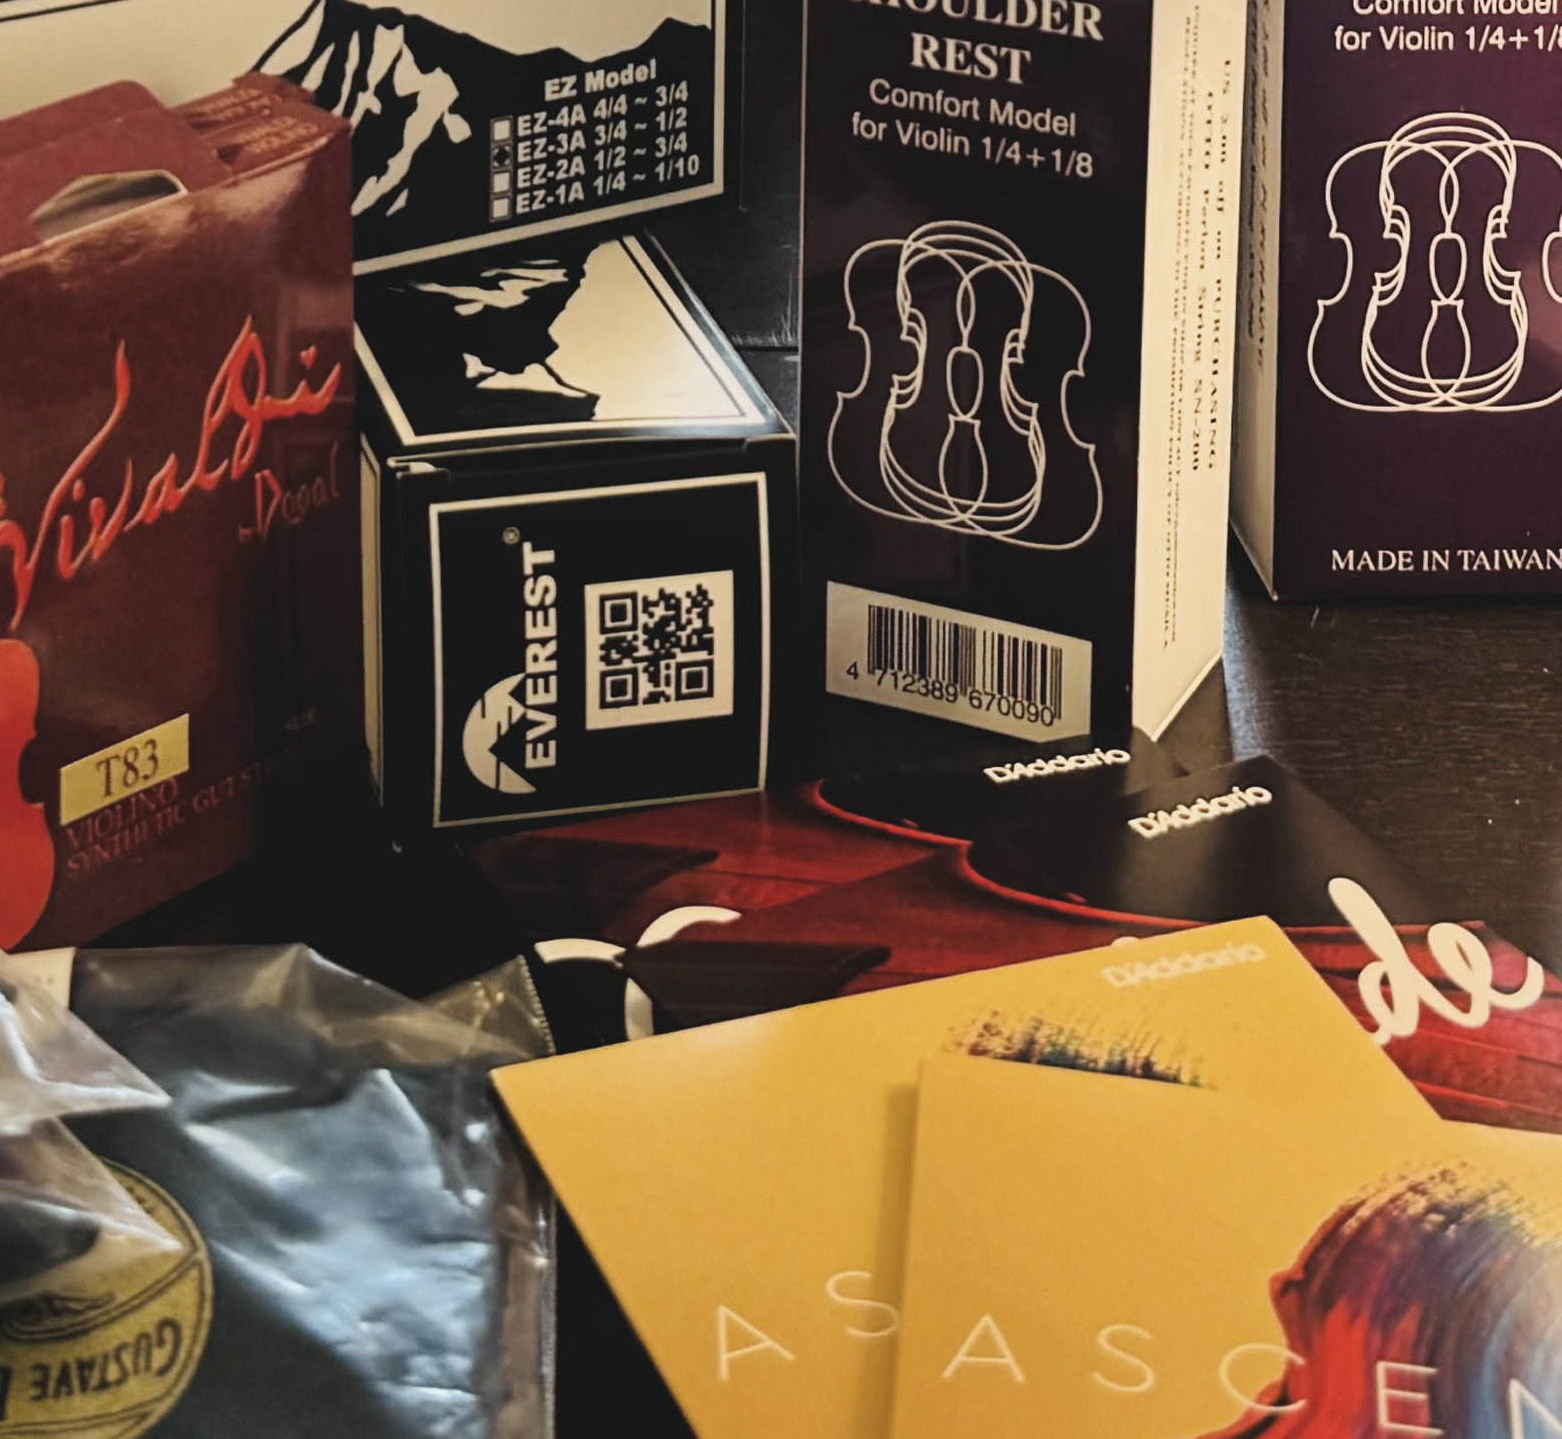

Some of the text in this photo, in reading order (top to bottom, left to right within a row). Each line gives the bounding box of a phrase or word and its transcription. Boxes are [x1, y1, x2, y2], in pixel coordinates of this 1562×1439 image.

[910, 31, 1033, 86] REST
[1334, 24, 1455, 52] for Violin
[517, 80, 690, 137] EZ-4A 4/4 3/4
[543, 57, 658, 102] EZ Model
[868, 77, 1076, 138] Comfort Model
[517, 105, 689, 164] EZ-3A 3/4 1/2
[517, 130, 688, 190] EZ-2A 1/2 3/4
[852, 111, 1094, 179] for Violin 1/4+1/8
[515, 154, 701, 216] EZ-1A 1/4 1/10
[1331, 546, 1562, 575] MADE IN TAIWAN
[523, 541, 557, 770] EVEREST
[846, 661, 1056, 729] 4 712389 670090
[95, 738, 160, 798] T83
[983, 745, 1131, 784] D'Addario
[63, 776, 181, 852] VIOLINO
[191, 784, 225, 817] GUT
[1127, 782, 1273, 840] D'Addario
[1099, 939, 1267, 990] D'Addario
[30, 1317, 184, 1404] GUSTAVE
